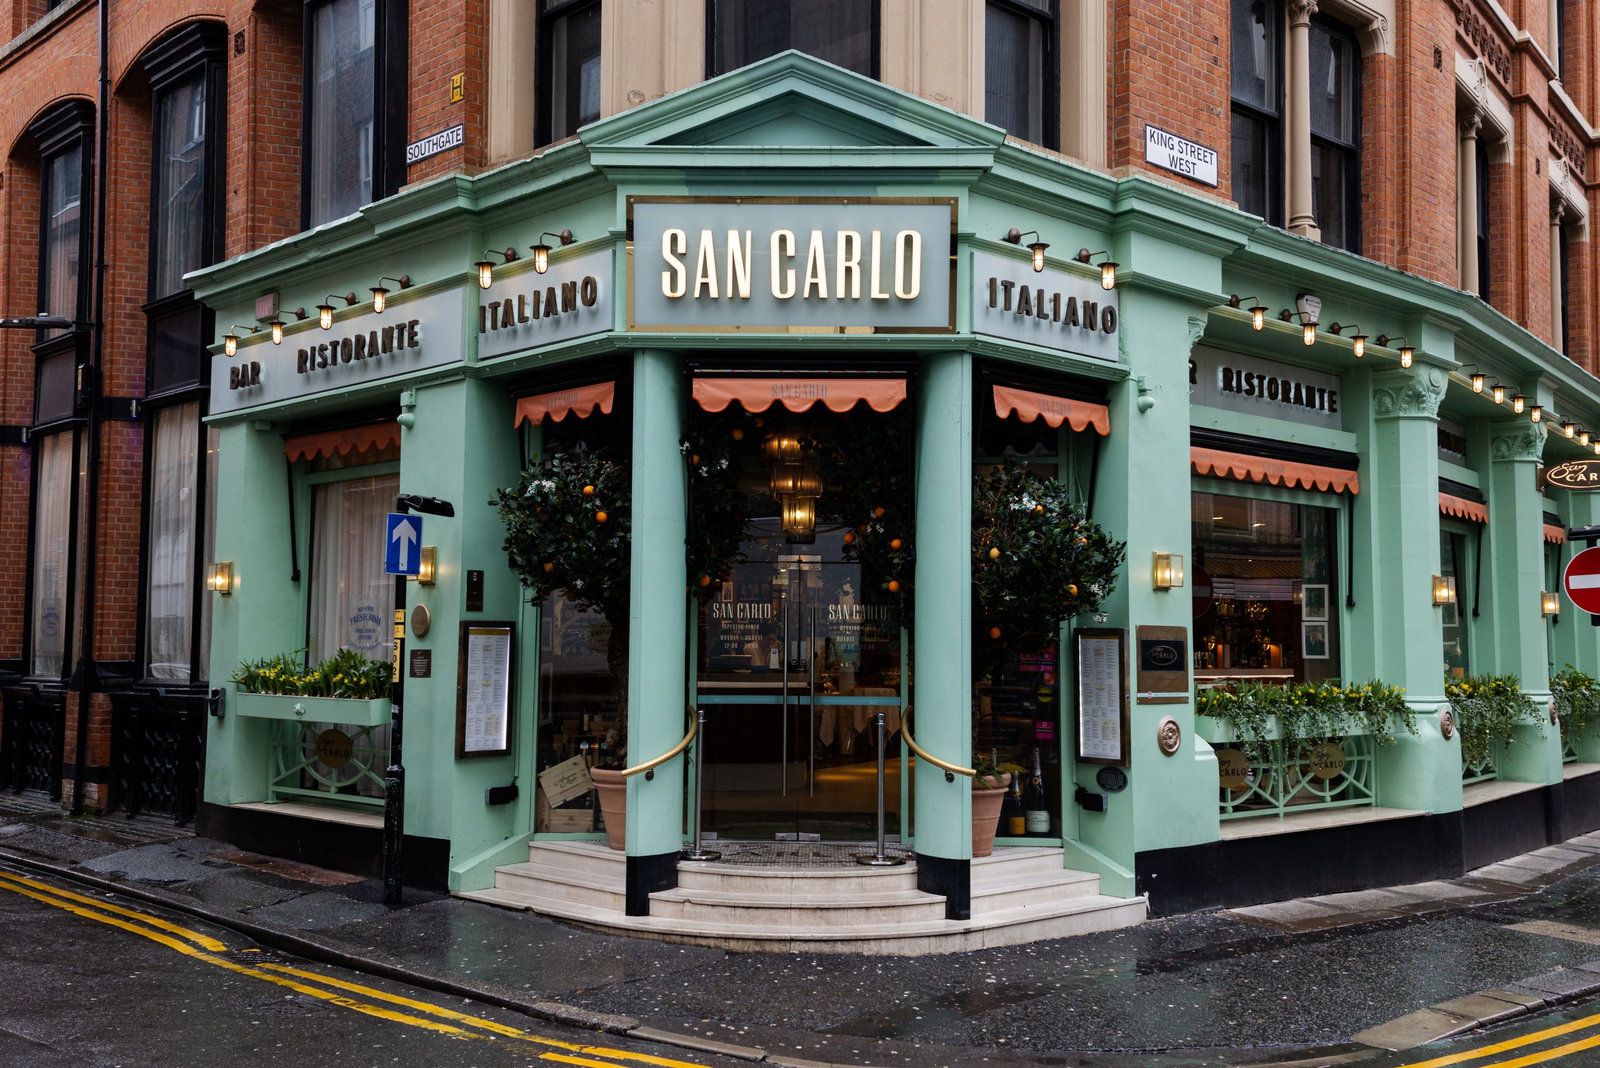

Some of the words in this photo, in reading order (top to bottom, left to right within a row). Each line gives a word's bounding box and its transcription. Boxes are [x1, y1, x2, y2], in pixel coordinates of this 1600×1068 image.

[408, 128, 462, 160] SOUTHGATE
[1149, 129, 1175, 151] KING
[1177, 140, 1214, 165] STREET
[1168, 153, 1197, 175] WEST
[661, 228, 752, 298] SAN
[770, 229, 922, 299] CARLO
[479, 275, 598, 333] ITALIANO
[989, 277, 1117, 334] ITALIANO
[229, 361, 261, 390] BAR
[297, 319, 420, 374] RISTORANTE
[771, 384, 792, 398] SAN
[794, 384, 828, 399] CARLO
[1222, 366, 1338, 413] RISTORANTE
[1551, 462, 1588, 479] San
[350, 613, 368, 625] FRESH
[368, 613, 382, 625] FISH
[713, 602, 734, 619] SAN
[737, 602, 771, 619] CARLO
[828, 603, 850, 620] SAN
[853, 604, 887, 620] CARLO
[324, 748, 350, 758] CARLO
[1219, 767, 1247, 777] CARLO
[1319, 760, 1344, 770] CARLO
